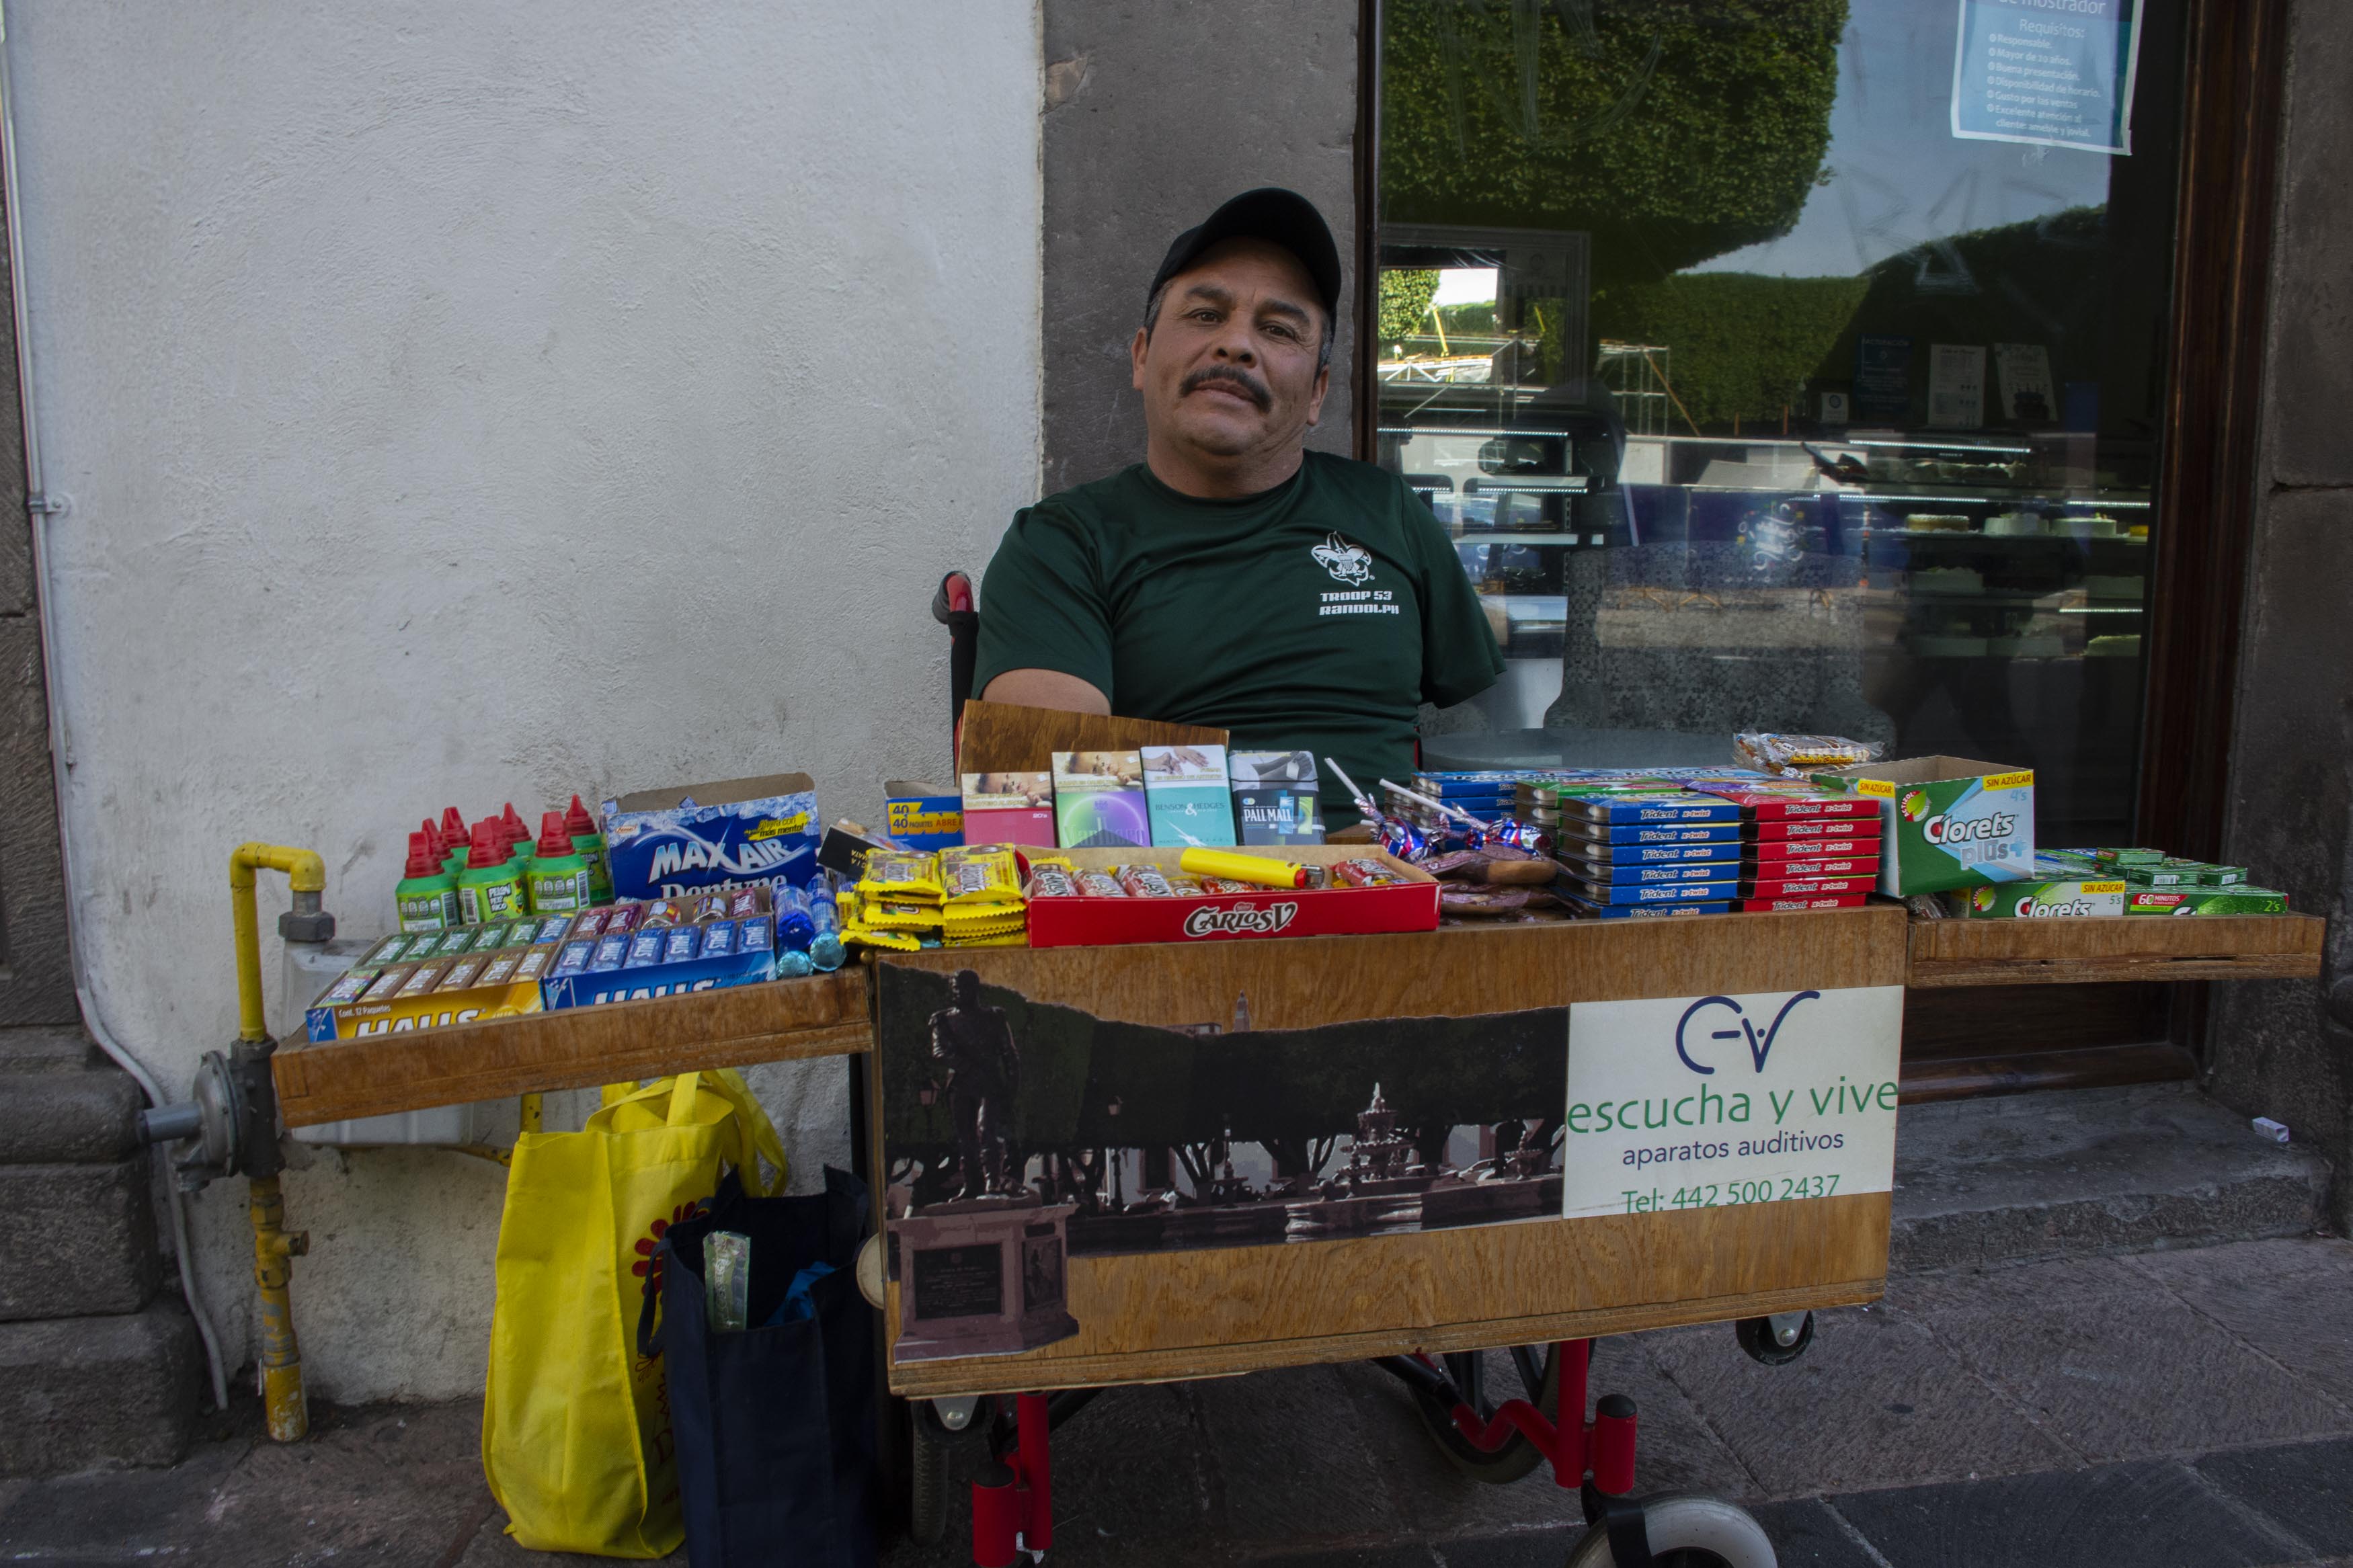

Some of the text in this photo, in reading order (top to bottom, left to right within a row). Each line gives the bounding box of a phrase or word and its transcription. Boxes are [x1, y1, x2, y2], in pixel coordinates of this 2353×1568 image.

[2026, 52, 2036, 61] de
[2021, 96, 2035, 104] por
[1320, 590, 1392, 602] TROOP 53
[1986, 773, 2032, 788] SIN AZÚCAR
[1244, 809, 1293, 822] PALL MALL
[1640, 809, 1711, 820] Trident x-twist
[1786, 804, 1853, 815] Trident x-twist
[777, 823, 804, 835] mentol
[893, 817, 908, 829] 40
[1923, 811, 2016, 845] Clorets
[1640, 830, 1710, 841] Trident x-twist
[1787, 824, 1853, 835] Trident x-twist
[1642, 849, 1712, 860] Trident x-twist
[1786, 843, 1852, 854] Trident x-twist
[648, 838, 793, 884] MAX AIR
[1786, 862, 1851, 874] Trident x-twist
[1641, 869, 1710, 880] Trident x-twist
[1782, 882, 1848, 893] Trident x-twist
[2083, 882, 2123, 893] SIN AZÚCAR
[1640, 888, 1709, 900] Trident x-twist
[2139, 895, 2153, 905] 60
[1772, 899, 1838, 911] Trident x-twist
[2013, 895, 2093, 917] Clorets
[1183, 901, 1299, 937] CARLOS V
[1630, 909, 1667, 917] Trident
[1567, 1075, 1899, 1134] escucha y vive
[1622, 1130, 1844, 1171] aparatos auditivos
[1622, 1174, 1841, 1214] Tel: 442 500 2437
